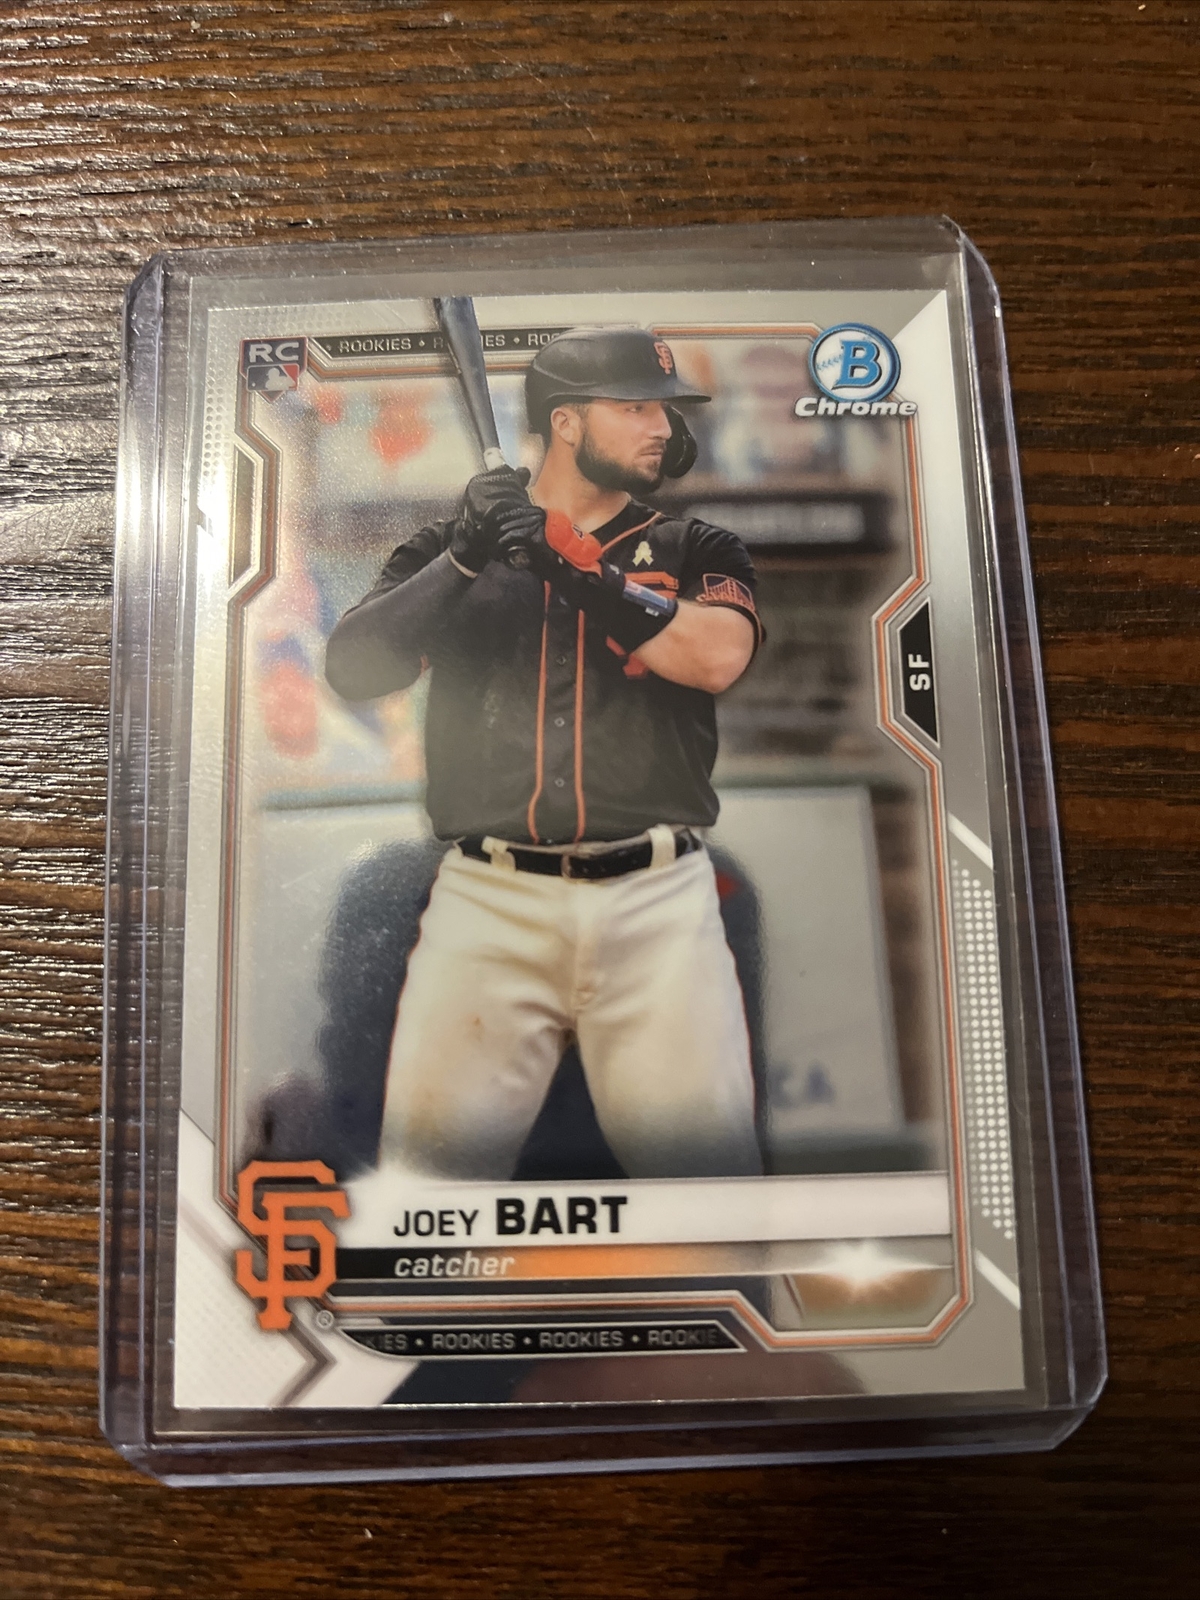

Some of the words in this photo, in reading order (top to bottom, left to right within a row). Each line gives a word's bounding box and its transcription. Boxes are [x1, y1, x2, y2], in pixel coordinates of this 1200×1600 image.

[248, 342, 299, 363] RC
[339, 338, 412, 353] ROOKIES
[794, 396, 918, 417] Chrome
[907, 653, 931, 691] SF
[393, 1209, 479, 1237] JOEY
[496, 1195, 628, 1235] BART
[394, 1250, 516, 1278] catcher
[432, 1332, 516, 1350] ROOKIES
[539, 1330, 624, 1348] ROOKIES
